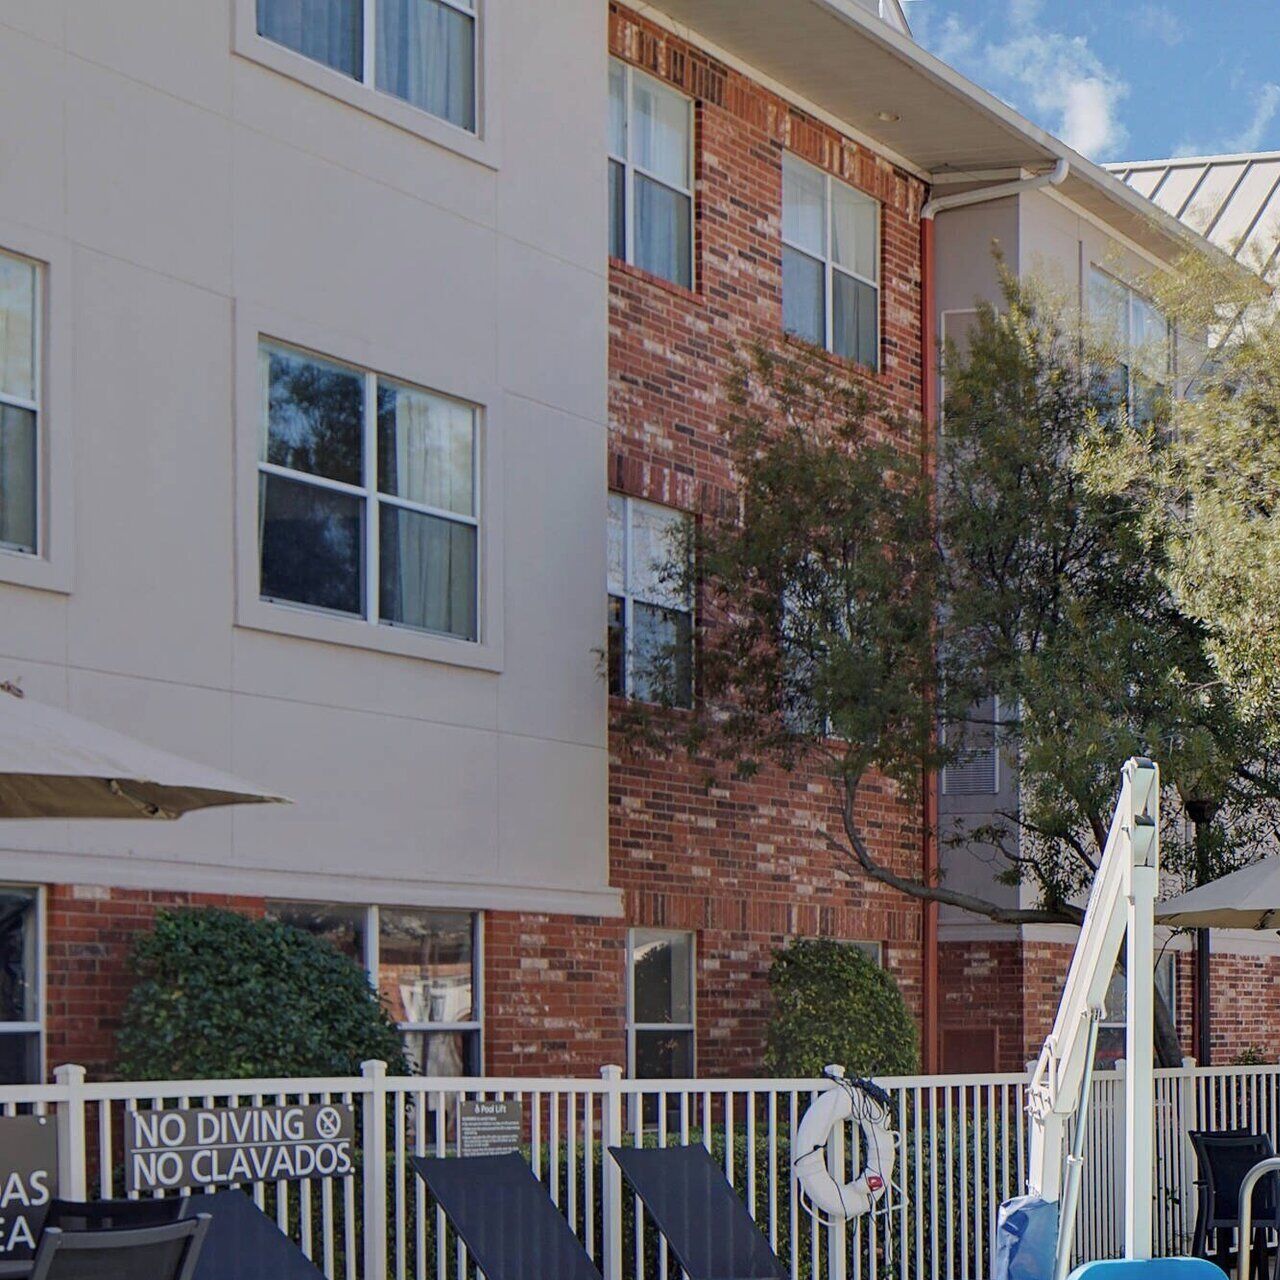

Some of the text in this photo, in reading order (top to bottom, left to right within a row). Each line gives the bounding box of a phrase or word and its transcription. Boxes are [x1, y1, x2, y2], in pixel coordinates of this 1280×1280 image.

[135, 1109, 304, 1148] NO DIVING
[133, 1143, 352, 1190] NO CLAVADOS
[0, 1170, 49, 1208] AS
